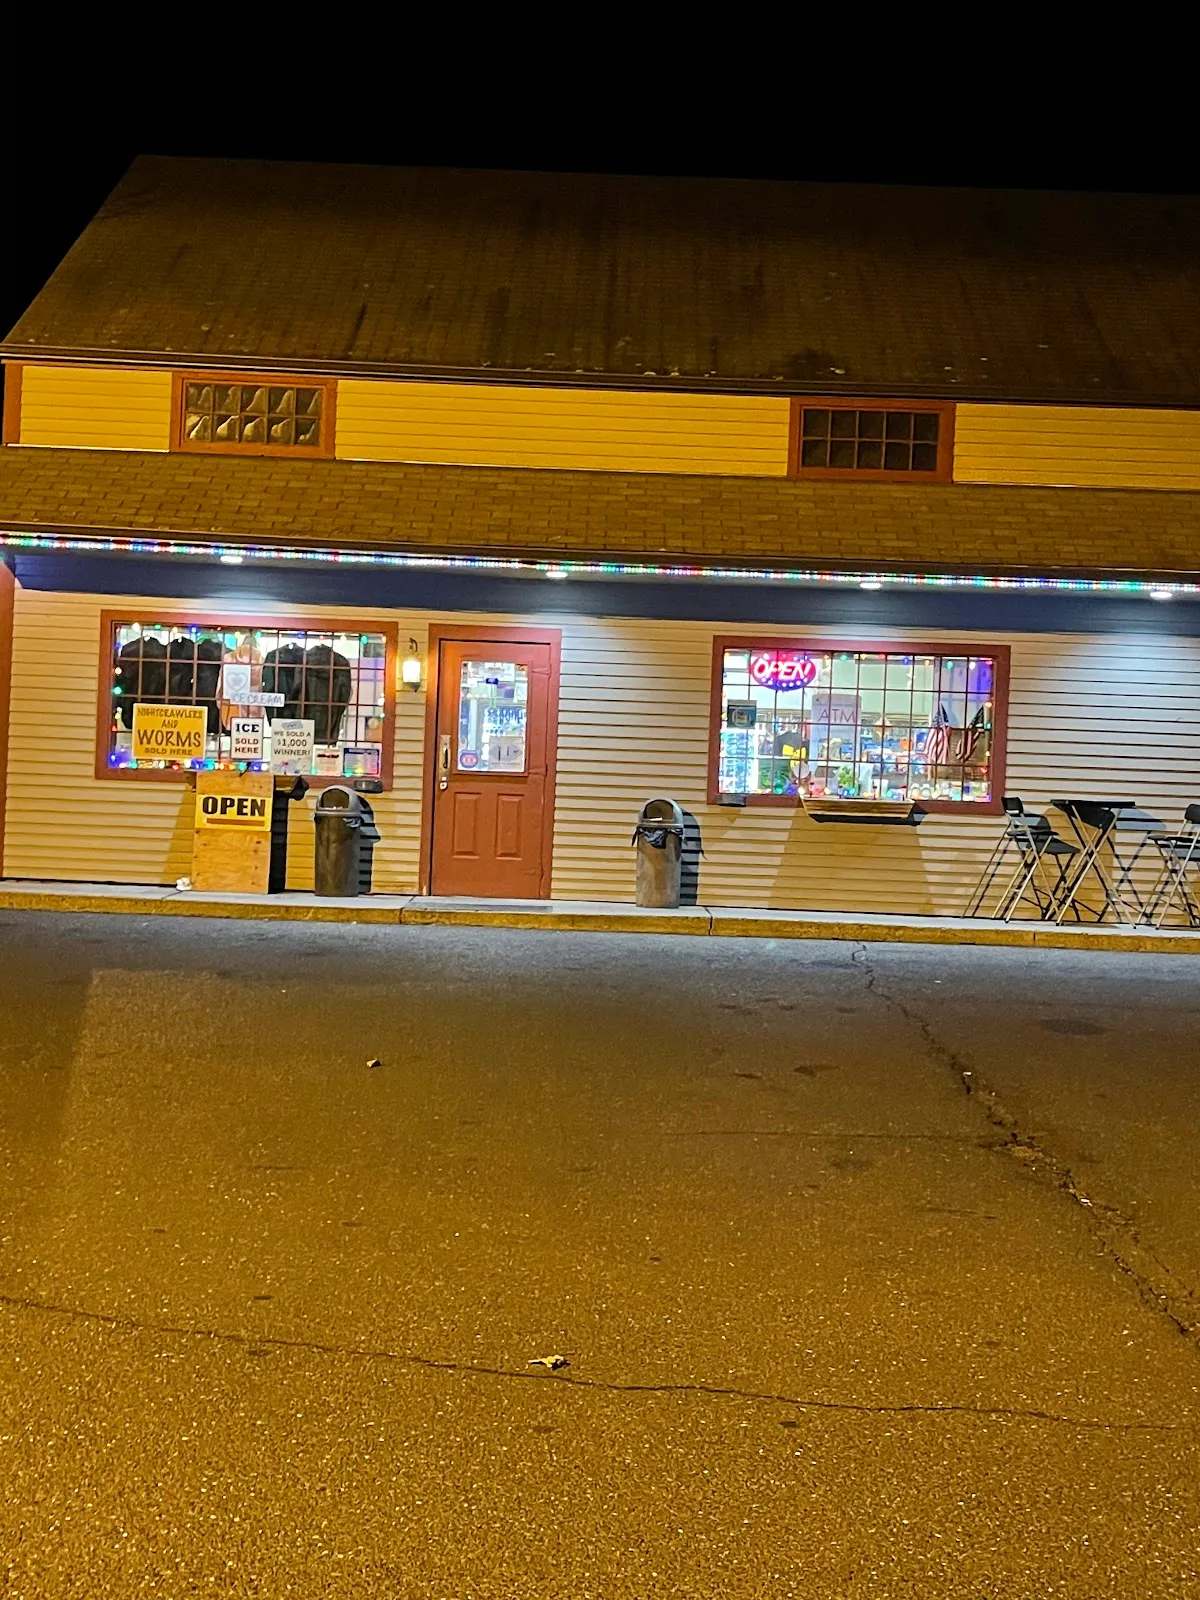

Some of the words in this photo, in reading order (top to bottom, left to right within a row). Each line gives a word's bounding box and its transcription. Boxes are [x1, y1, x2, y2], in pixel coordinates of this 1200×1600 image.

[753, 660, 811, 680] OPEN
[818, 708, 855, 723] ATM
[161, 719, 178, 729] AND
[235, 723, 259, 733] ICE
[137, 729, 201, 748] WORMS
[235, 737, 259, 745] SOLD
[277, 739, 307, 747] $1,000
[144, 747, 167, 755] SOLD
[169, 748, 193, 756] HERE
[234, 746, 259, 754] HERE
[273, 748, 311, 756] WINNER!
[202, 796, 266, 817] OPEN
